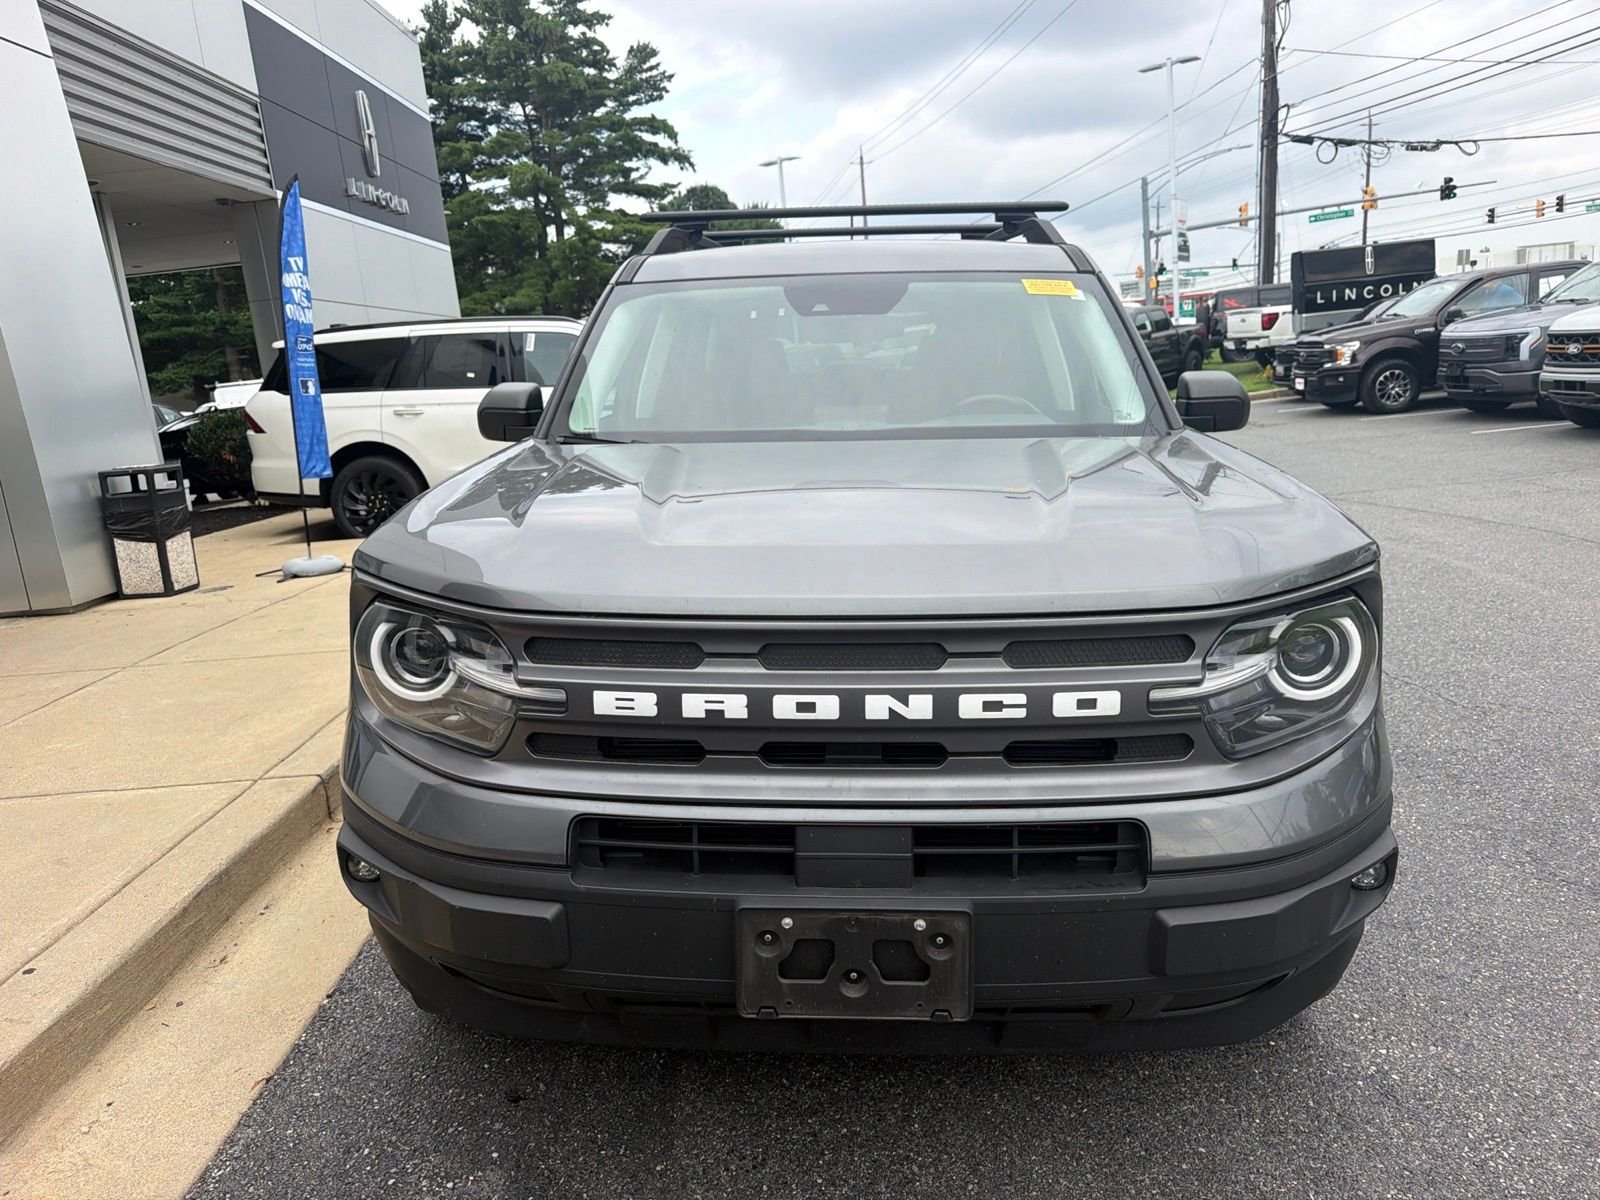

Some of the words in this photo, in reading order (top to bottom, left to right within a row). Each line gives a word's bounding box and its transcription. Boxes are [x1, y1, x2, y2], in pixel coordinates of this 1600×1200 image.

[346, 178, 409, 214] LINCOLN
[1317, 280, 1424, 304] LINCOLN
[593, 690, 1121, 720] BRONCO
